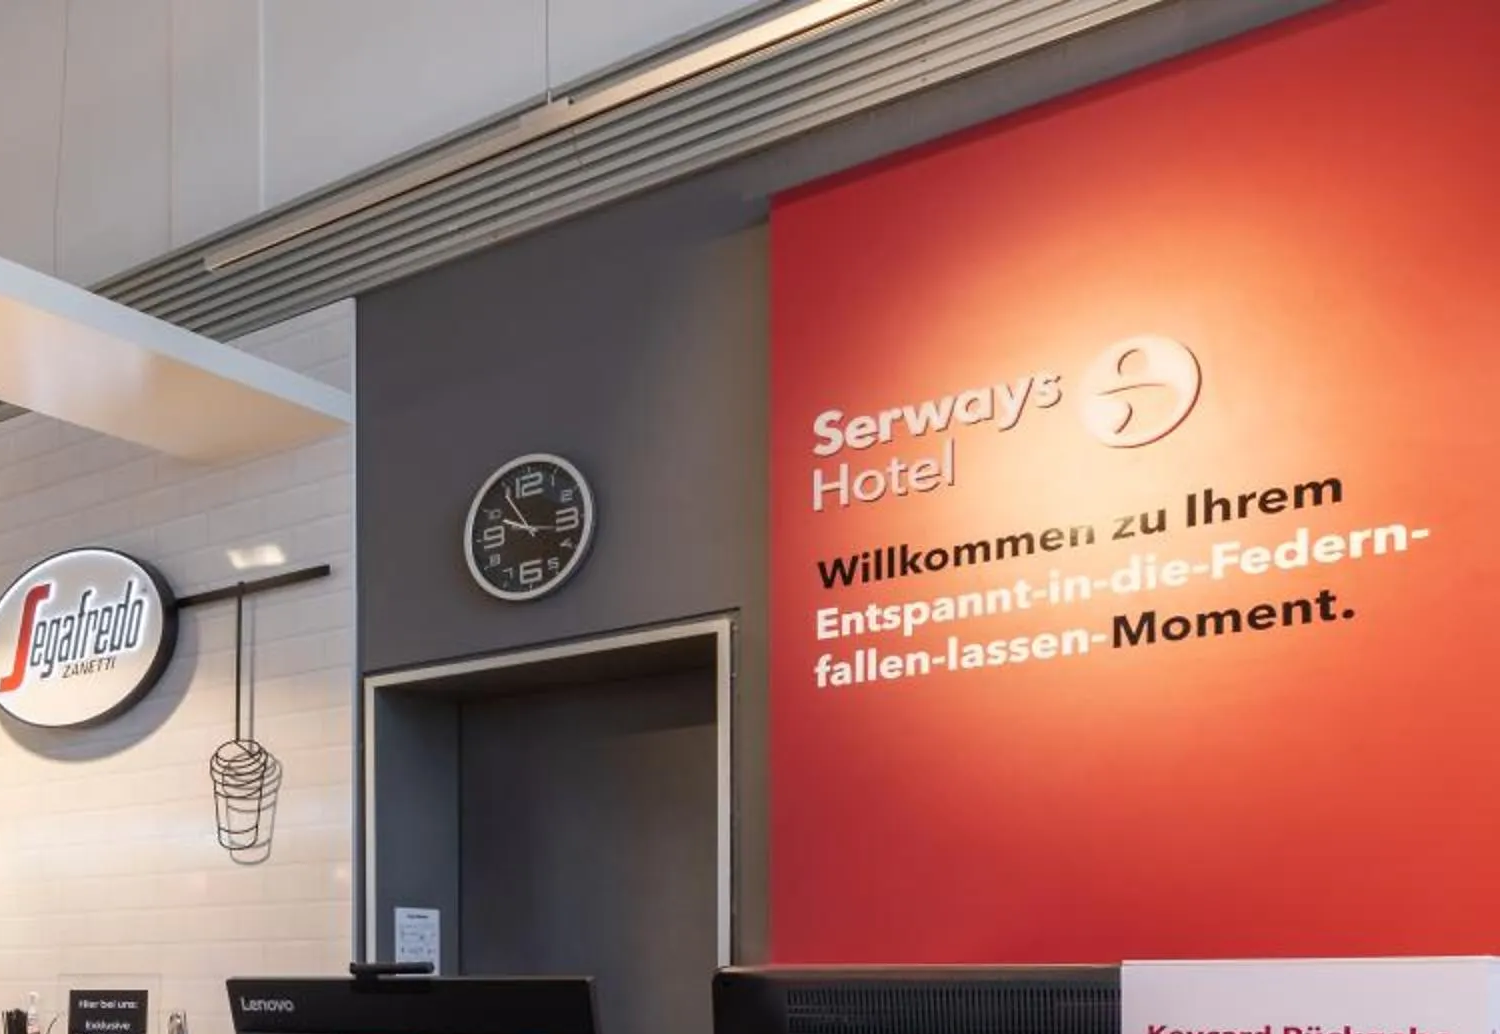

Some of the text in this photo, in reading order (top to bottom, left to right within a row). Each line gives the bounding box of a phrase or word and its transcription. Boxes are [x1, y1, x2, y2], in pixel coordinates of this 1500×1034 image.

[811, 369, 1063, 457] Serways
[515, 472, 544, 499] 12
[811, 439, 956, 512] Hotel
[555, 506, 579, 532] 3
[483, 525, 505, 549] 9
[817, 477, 1344, 591] Willkommen zu Ihrem
[519, 559, 543, 584] 6
[815, 520, 1431, 641] Entspannt-in-die-Federn-
[62, 656, 117, 678] ZANETTI
[241, 996, 295, 1012] Lenovo
[86, 1020, 130, 1030] Exklusive
